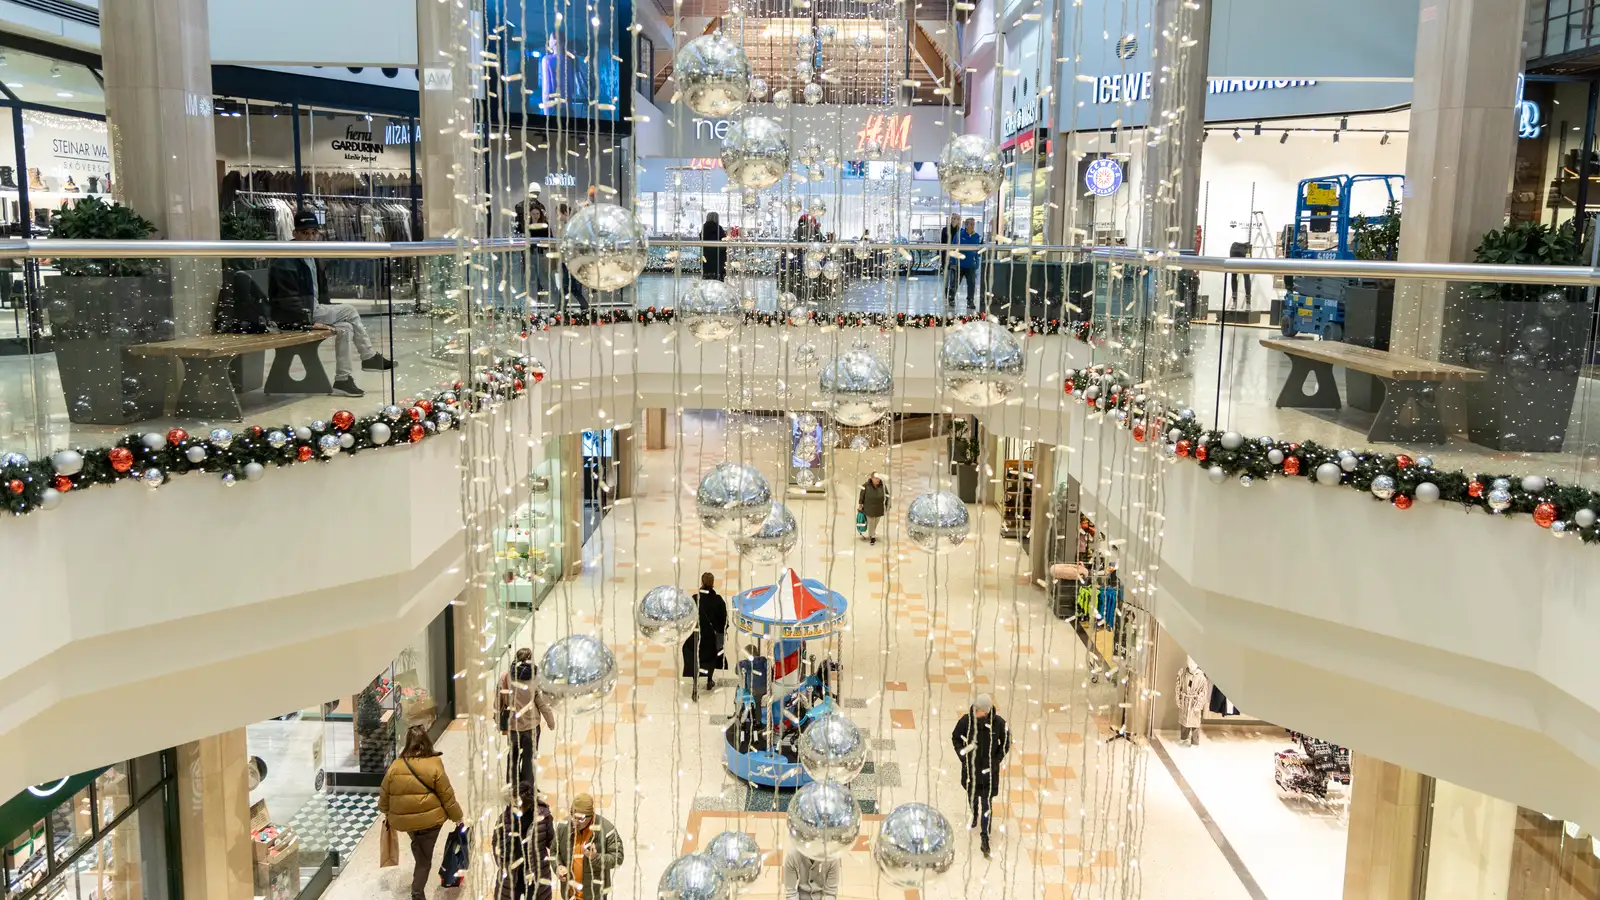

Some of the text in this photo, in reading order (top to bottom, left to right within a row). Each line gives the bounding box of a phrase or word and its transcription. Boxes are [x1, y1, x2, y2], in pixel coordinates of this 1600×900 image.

[1093, 72, 1151, 104] ICEWE
[696, 119, 729, 140] ne
[53, 138, 109, 158] STEINAR WA
[63, 160, 107, 173] SKÓVERSL
